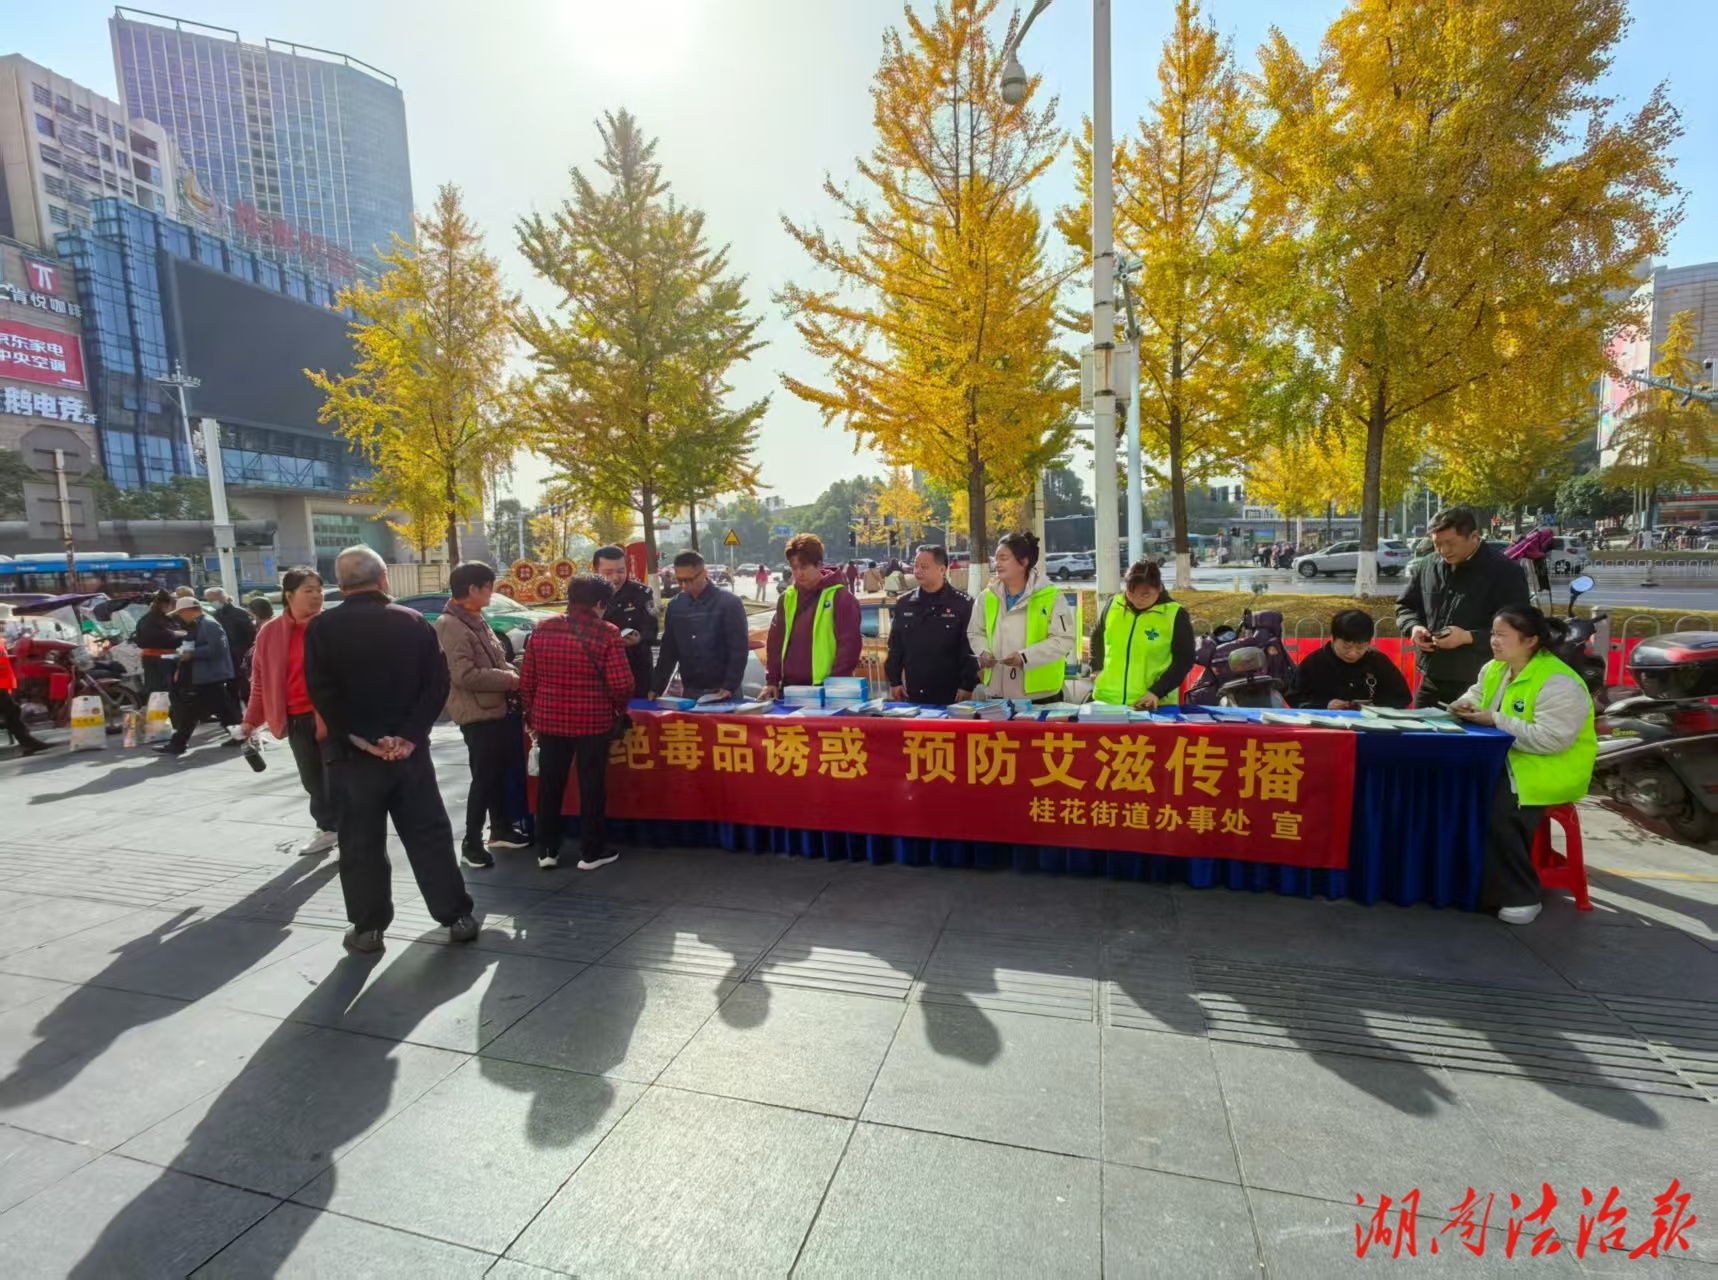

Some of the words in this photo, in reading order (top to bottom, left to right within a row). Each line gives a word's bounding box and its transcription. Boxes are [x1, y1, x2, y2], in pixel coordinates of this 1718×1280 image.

[0, 349, 67, 373] 中央空调
[0, 386, 85, 422] 鹅电竞
[608, 719, 869, 779] 绝毒品诱惑
[902, 730, 1305, 802] 预防艾滋传播
[1029, 796, 1252, 836] 桂花街道办事处
[1271, 811, 1303, 840] 宣
